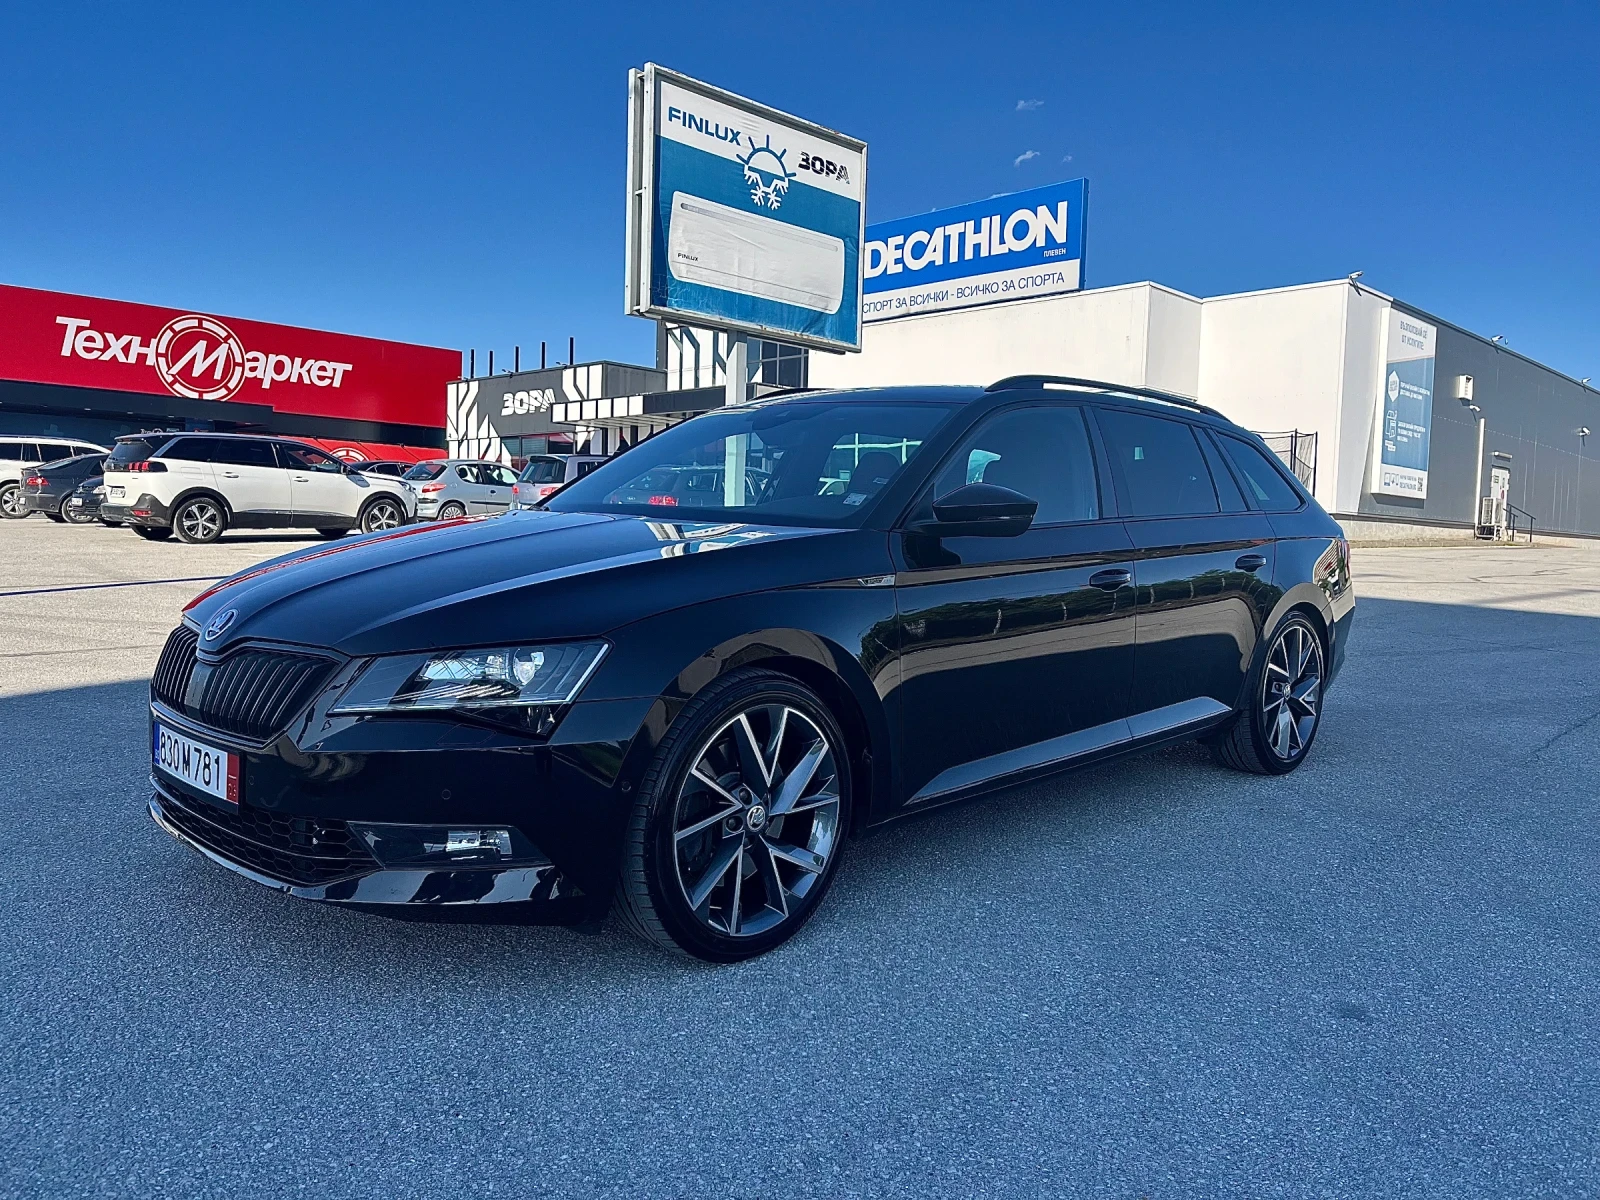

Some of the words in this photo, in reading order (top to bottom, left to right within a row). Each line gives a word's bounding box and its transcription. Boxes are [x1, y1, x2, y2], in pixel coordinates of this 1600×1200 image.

[668, 105, 742, 146] FINLUX
[797, 150, 850, 185] ЗОРА
[677, 252, 699, 262] FINLUX
[864, 200, 1068, 279] DECATHLON
[1043, 247, 1067, 258] ПЛЕВЕН
[862, 298, 894, 314] СПОРТ
[895, 295, 908, 308] ЗА
[909, 290, 949, 307] ВСИЧКИ
[956, 281, 1000, 300] ВСИЧКО
[1001, 277, 1016, 291] ЗА
[1017, 271, 1065, 290] СПОРТА
[500, 388, 556, 417] ЗОРА
